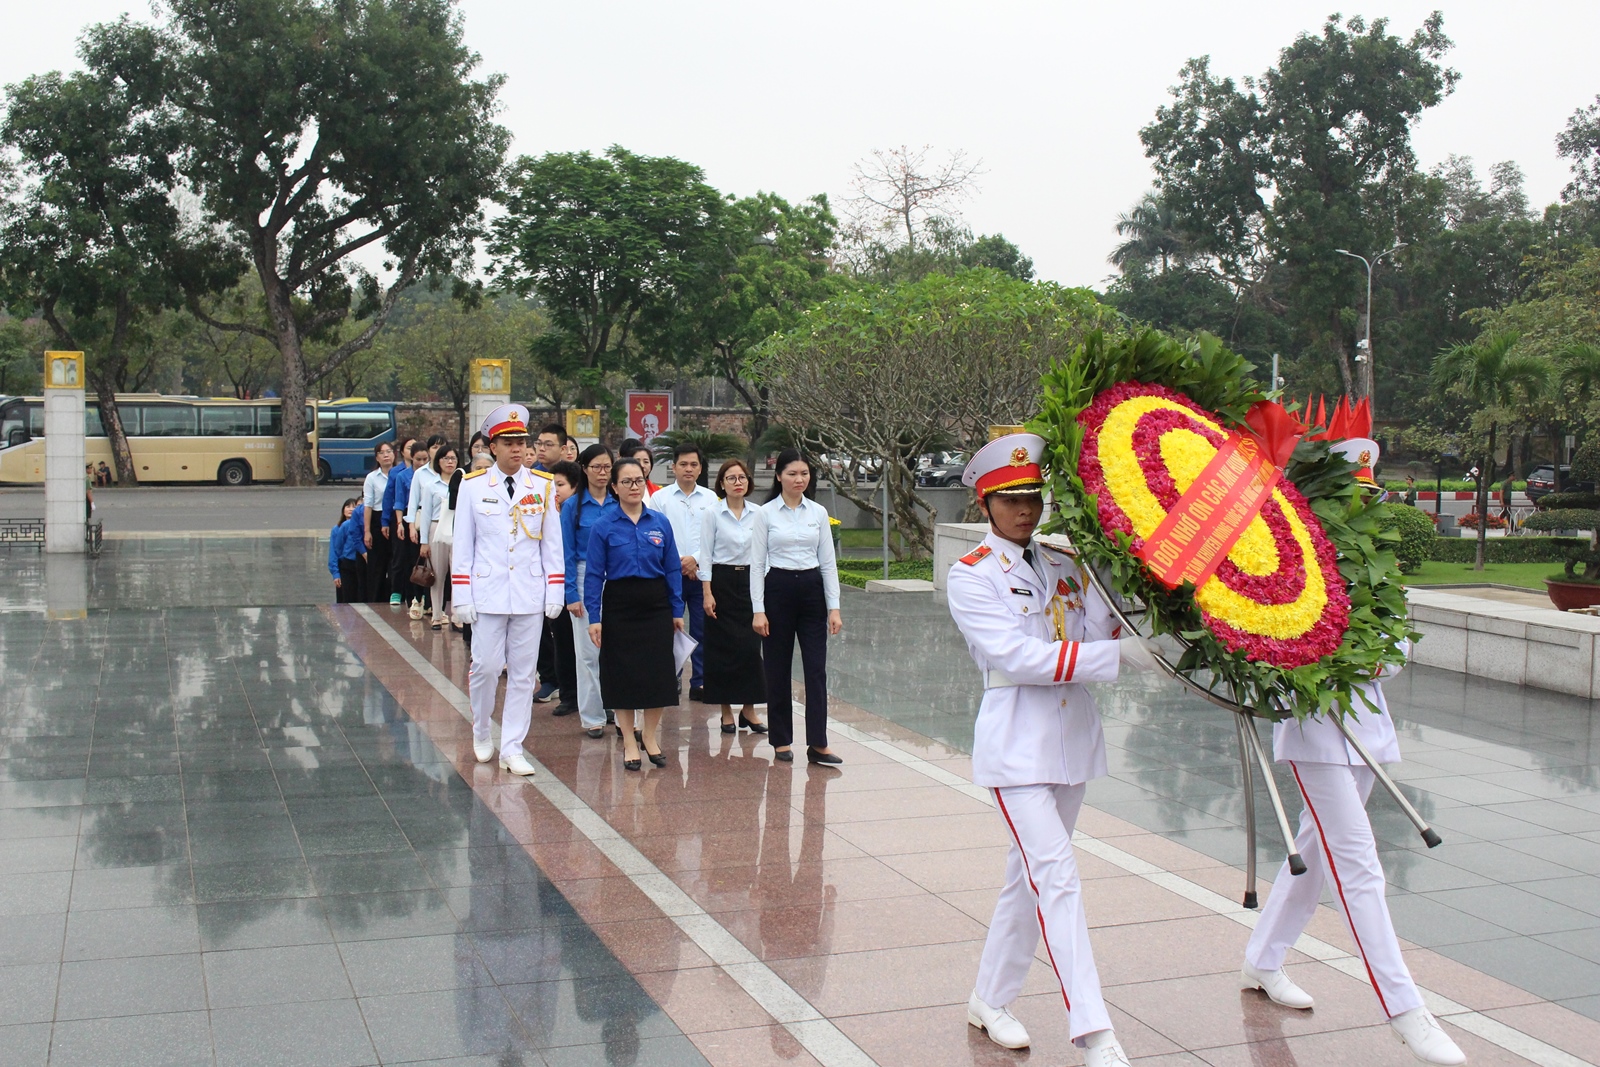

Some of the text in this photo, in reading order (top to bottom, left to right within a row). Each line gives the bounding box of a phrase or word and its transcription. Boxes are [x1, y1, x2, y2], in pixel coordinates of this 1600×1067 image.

[1216, 464, 1240, 489] ANH
[1201, 479, 1229, 505] CÁC
[1188, 498, 1215, 521] ƠN
[1223, 506, 1244, 528] QUỐC
[1169, 512, 1201, 546] NHỚ
[1212, 521, 1235, 543] NÔNG
[1153, 538, 1183, 568] ĐỜI
[1196, 535, 1223, 564] KHUYẾN
[1186, 557, 1207, 576] TÂM
